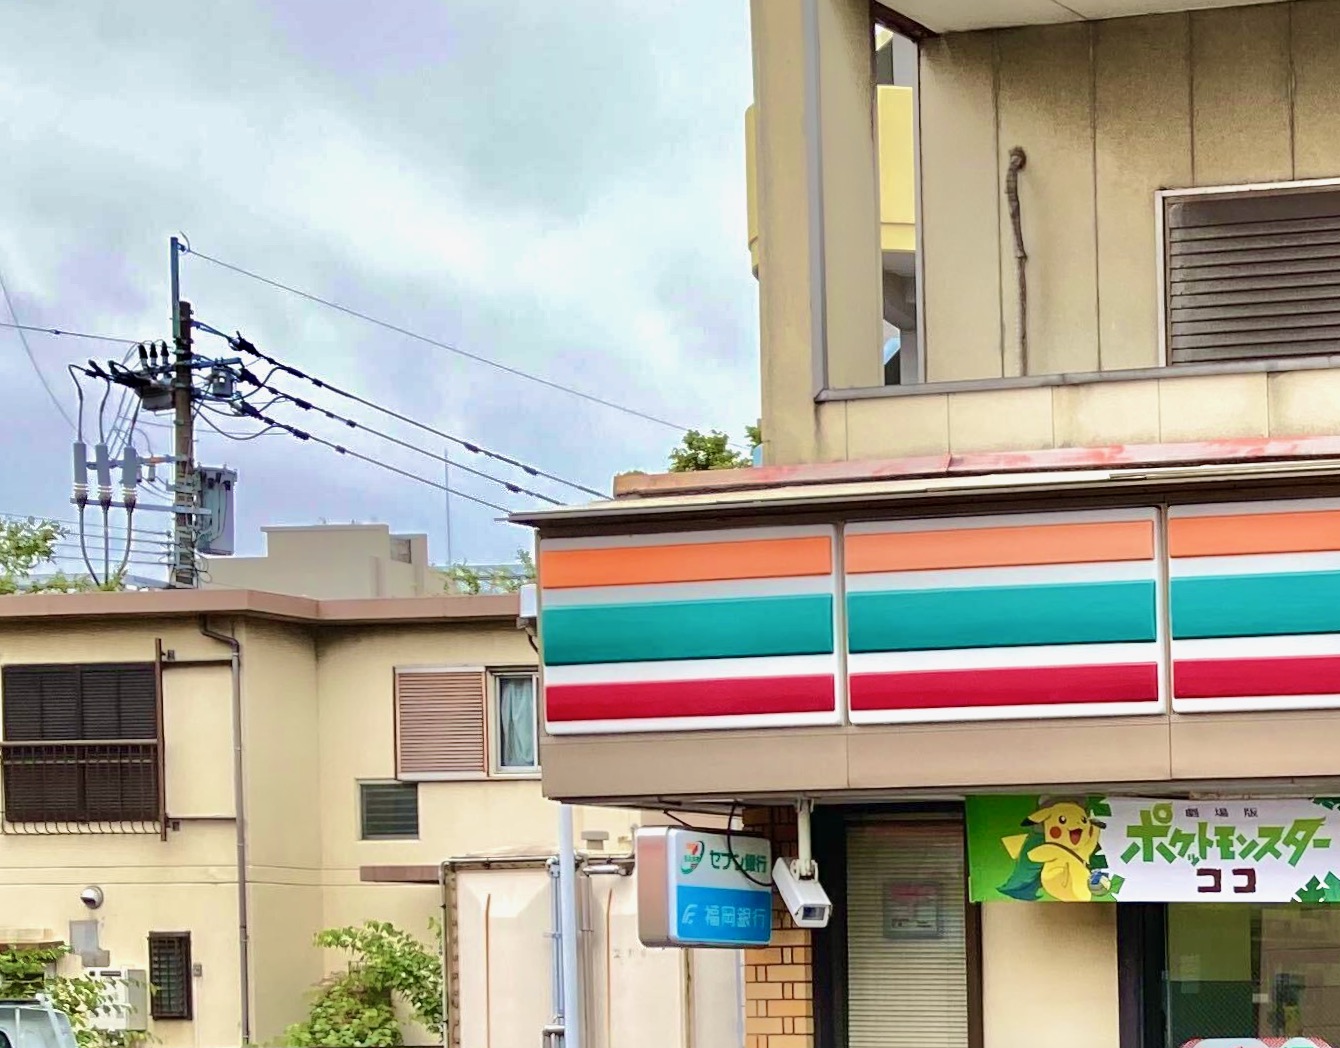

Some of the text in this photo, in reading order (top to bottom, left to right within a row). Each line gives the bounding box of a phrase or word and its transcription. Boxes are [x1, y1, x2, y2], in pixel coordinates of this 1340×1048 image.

[1120, 801, 1332, 868] ポケットモンスター
[1196, 867, 1257, 894] ココ
[704, 904, 766, 929] 福岡銀行
